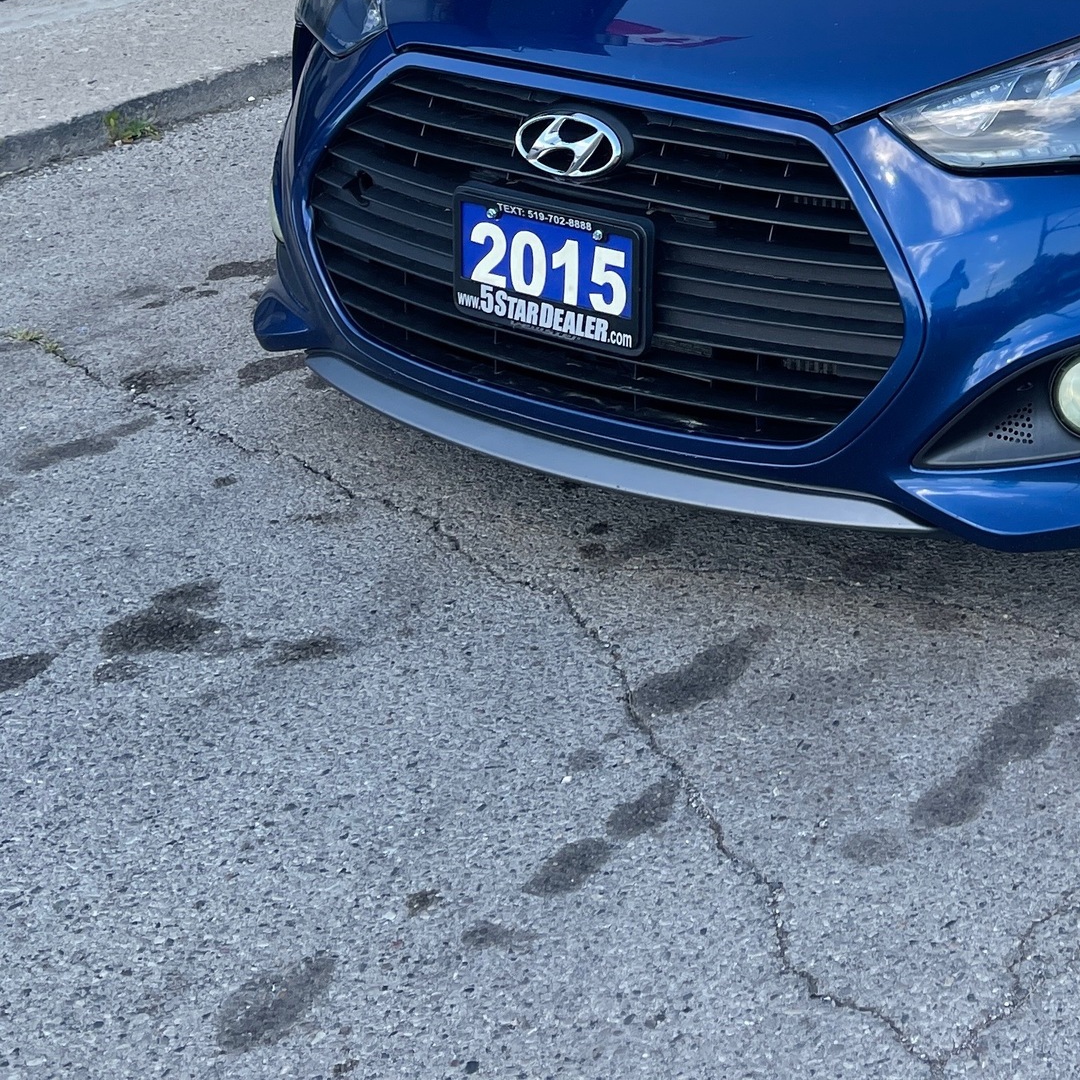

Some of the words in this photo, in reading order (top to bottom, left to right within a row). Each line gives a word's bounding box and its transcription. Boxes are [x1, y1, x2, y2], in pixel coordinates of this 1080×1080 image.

[496, 203, 526, 217] TEXT:
[527, 209, 592, 231] 519-702-8888
[470, 221, 627, 316] 2015
